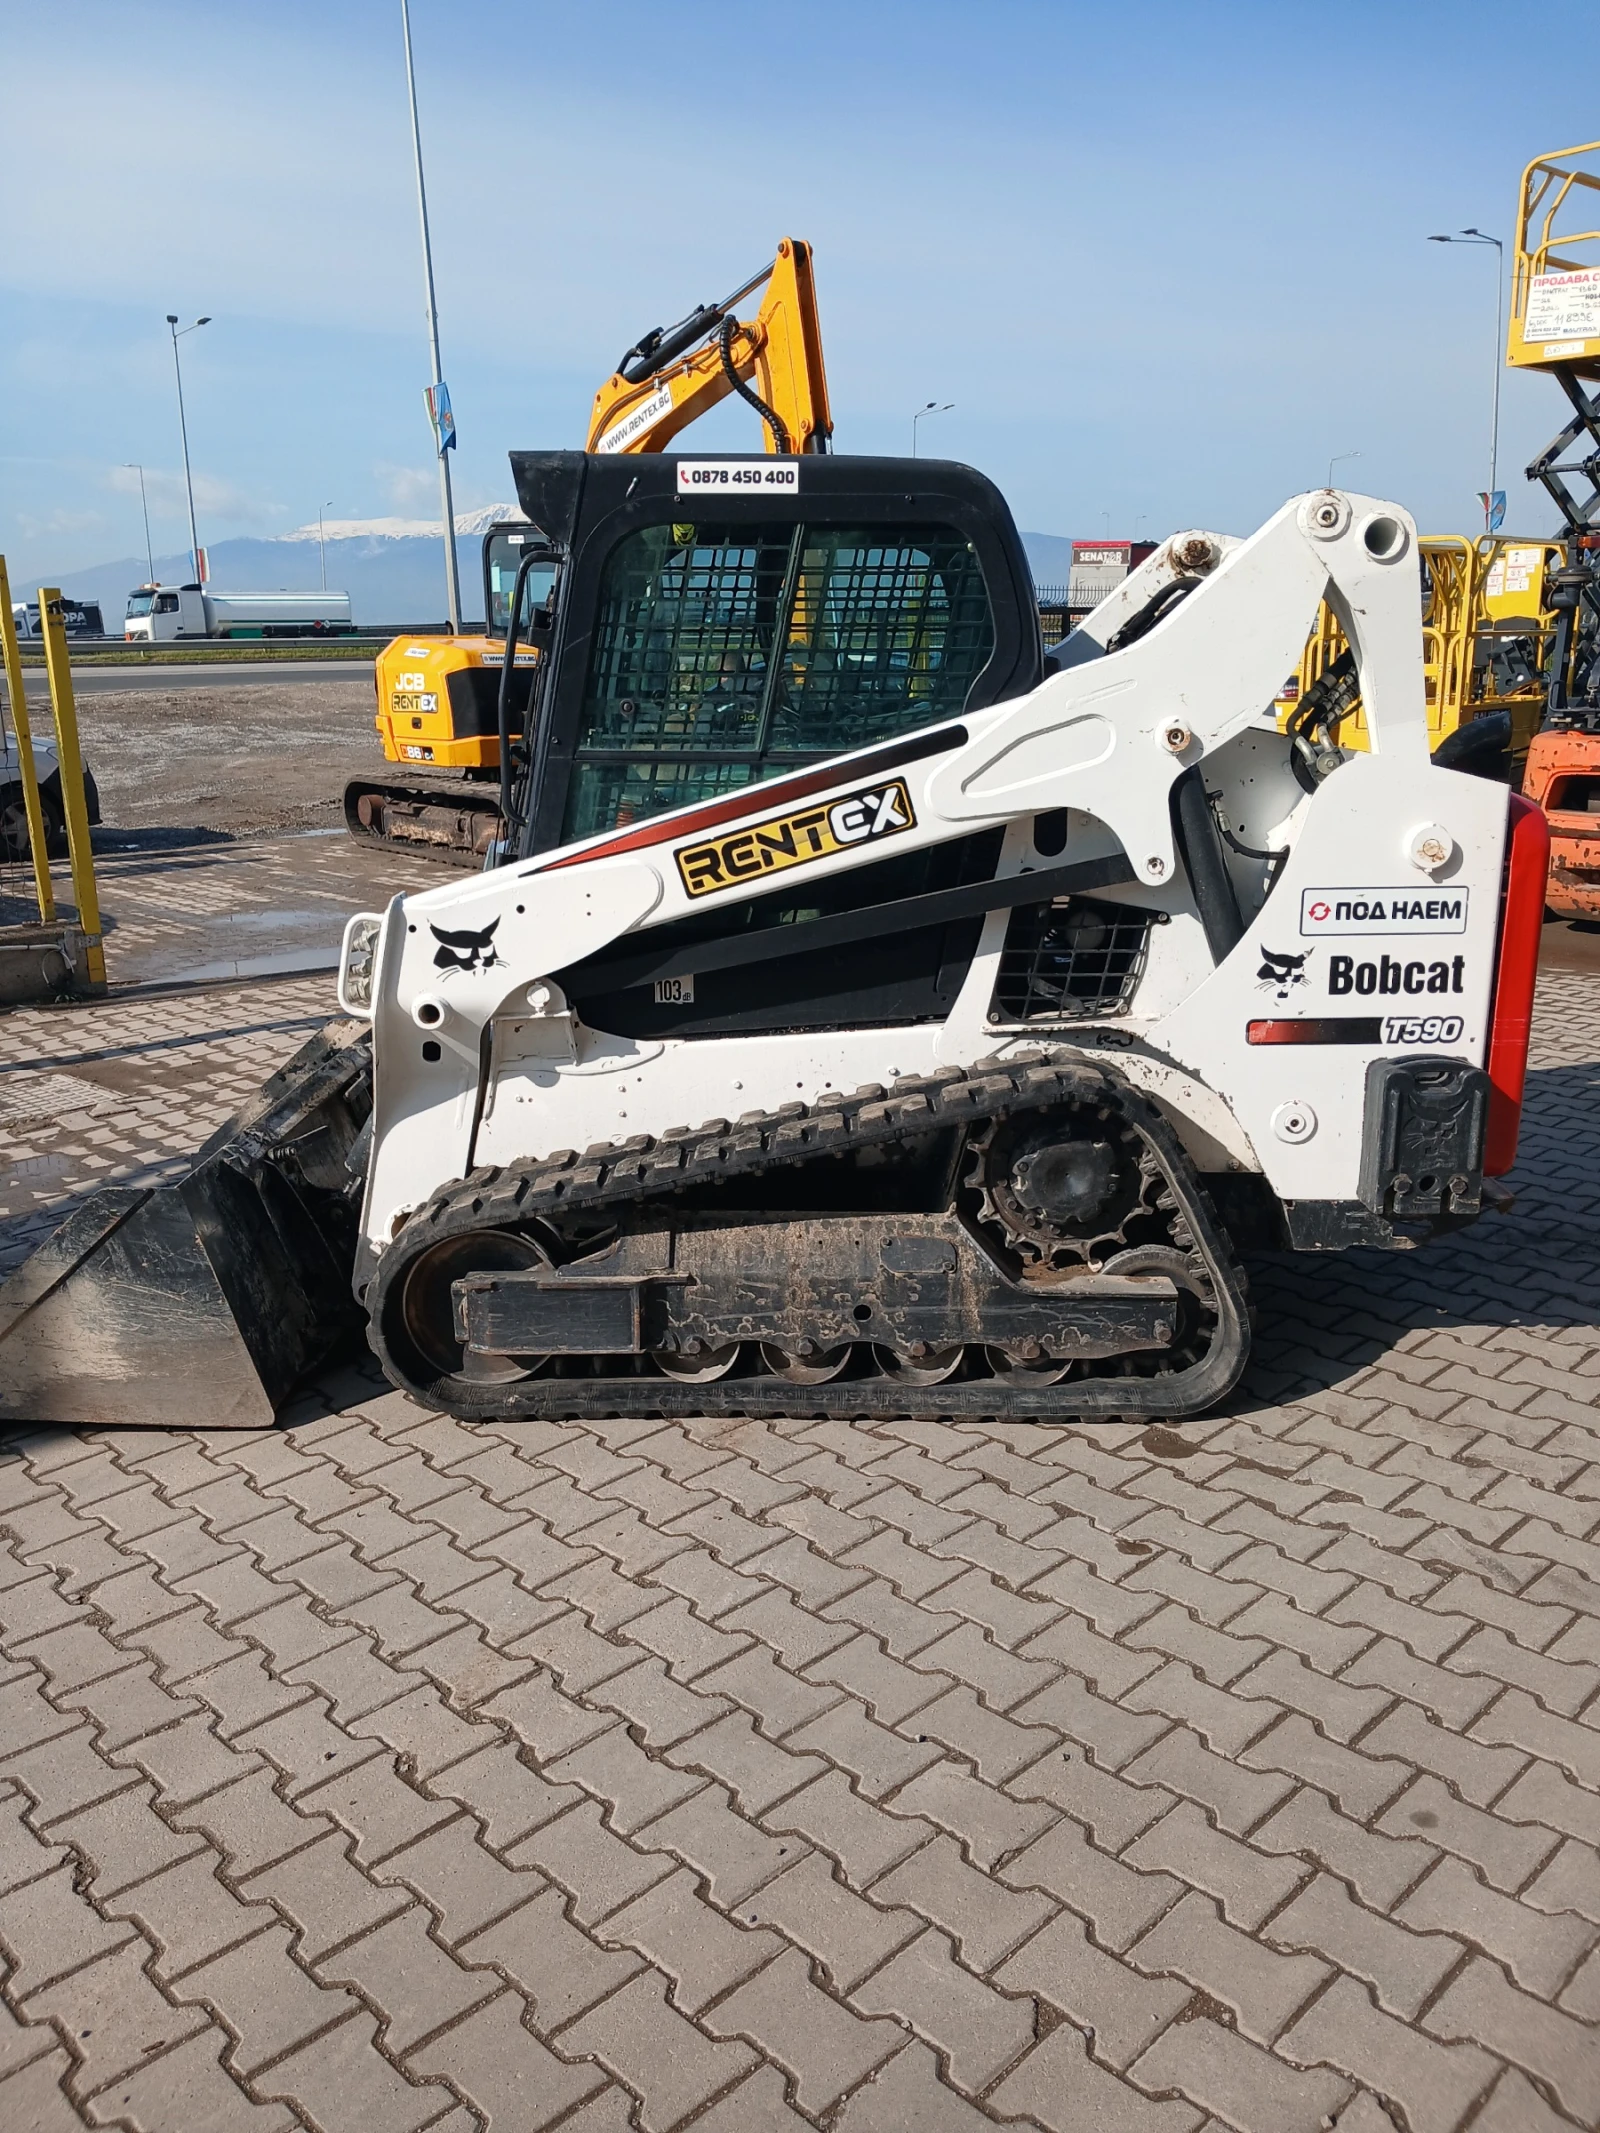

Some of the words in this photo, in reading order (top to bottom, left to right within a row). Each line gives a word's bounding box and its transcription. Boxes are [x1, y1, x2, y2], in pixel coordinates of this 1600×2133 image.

[1533, 274, 1590, 287] ПРОДАВА
[606, 392, 670, 451] WWW.RENTEX.BG
[692, 470, 729, 484] 0878
[732, 470, 762, 484] 450
[765, 470, 795, 484] 400
[1079, 551, 1122, 562] SENATOR
[395, 673, 425, 690] JCB
[393, 693, 437, 712] RENTEX
[684, 786, 908, 890] RENTEX
[1335, 901, 1387, 920] ПОД
[1391, 900, 1462, 920] НАЕМ
[1328, 954, 1465, 996] Bobcat
[656, 979, 682, 1001] 103
[1386, 1016, 1464, 1044] T590
